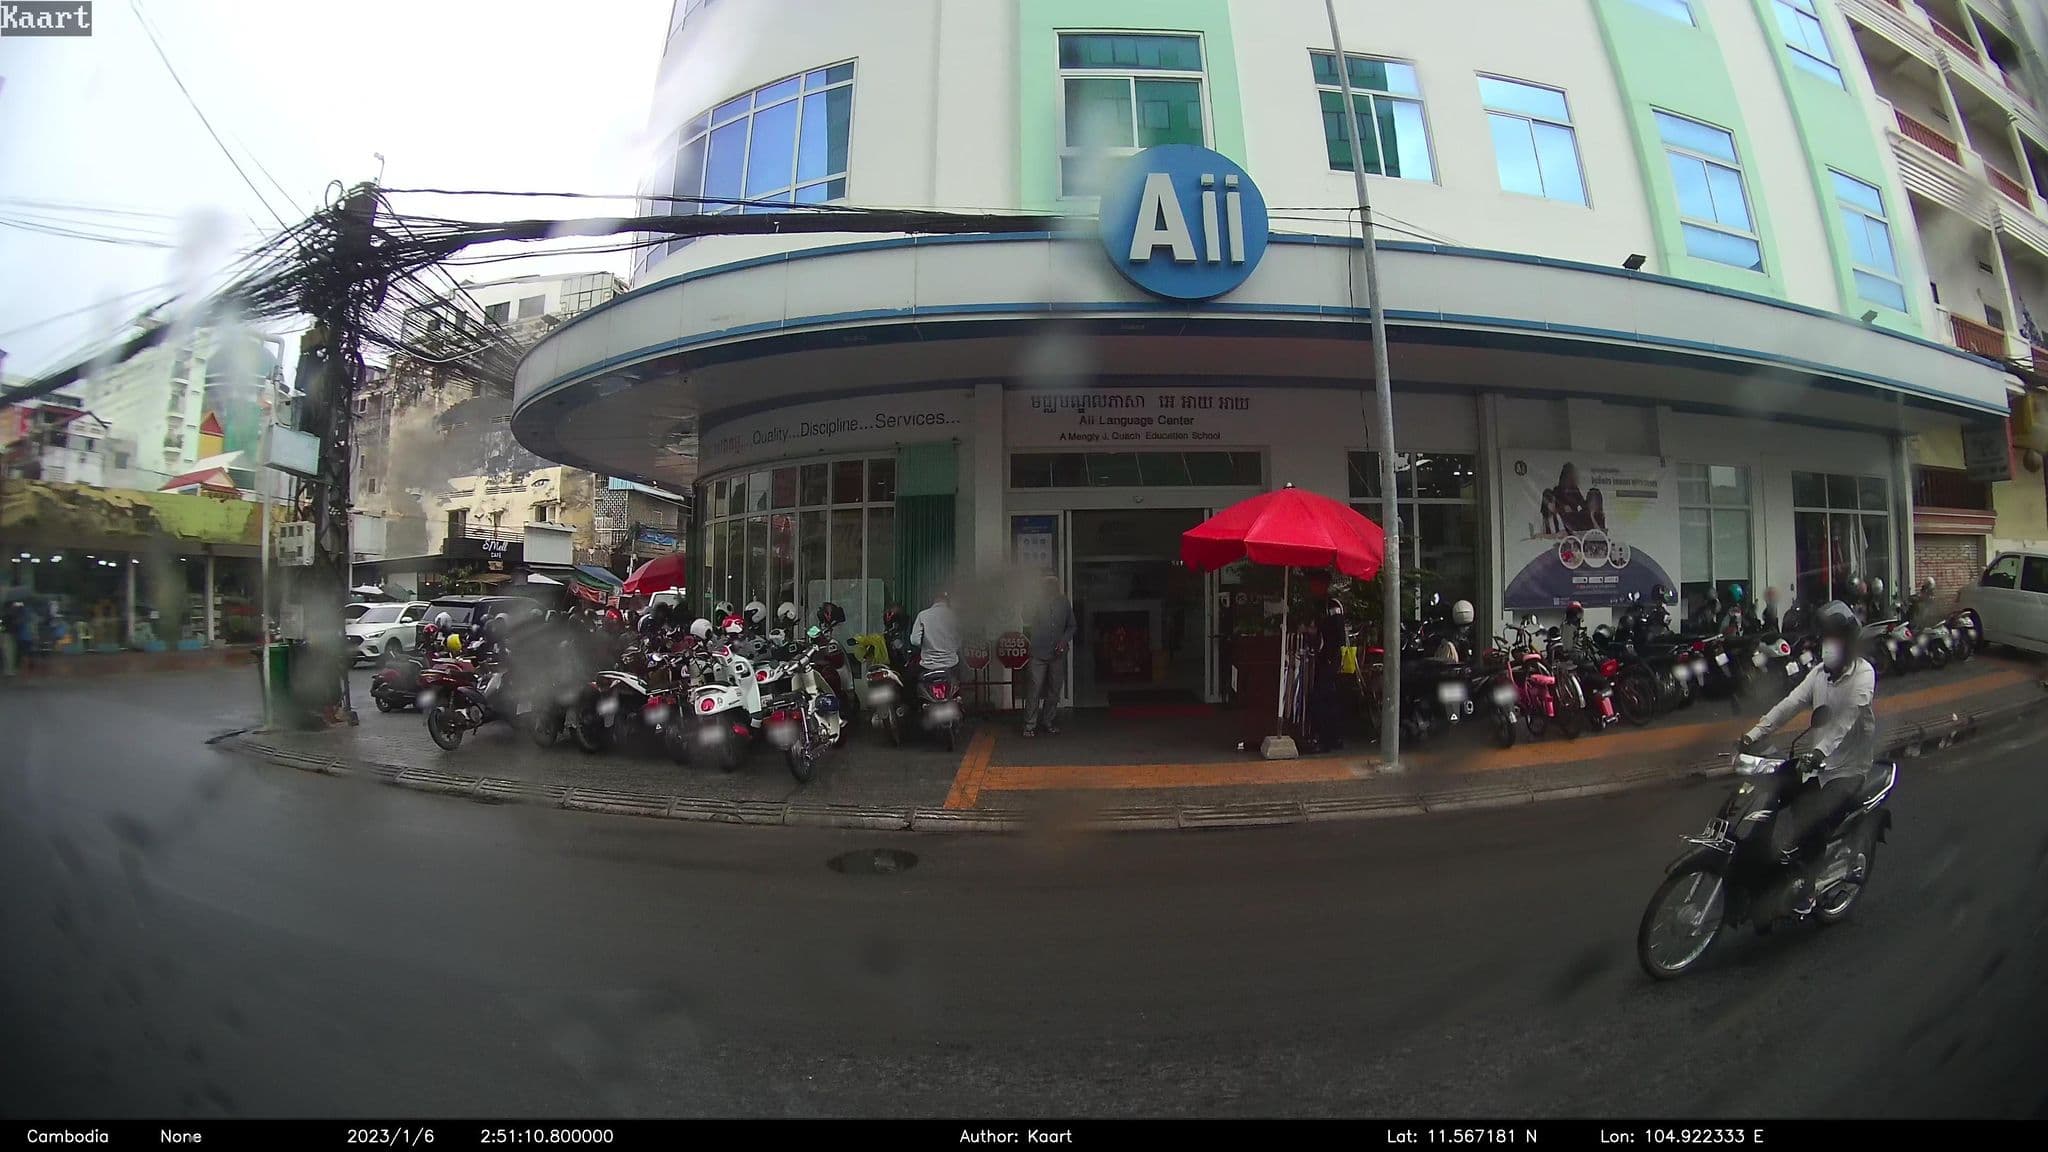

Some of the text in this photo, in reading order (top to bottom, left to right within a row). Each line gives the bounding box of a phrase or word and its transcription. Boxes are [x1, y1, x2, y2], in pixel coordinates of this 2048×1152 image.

[1129, 172, 1245, 264] Aii
[1099, 415, 1154, 427] Language
[1158, 415, 1195, 426] Center
[1060, 433, 1066, 441] A
[1145, 431, 1189, 441] Education
[1192, 431, 1221, 441] School
[999, 647, 1027, 657] STOP
